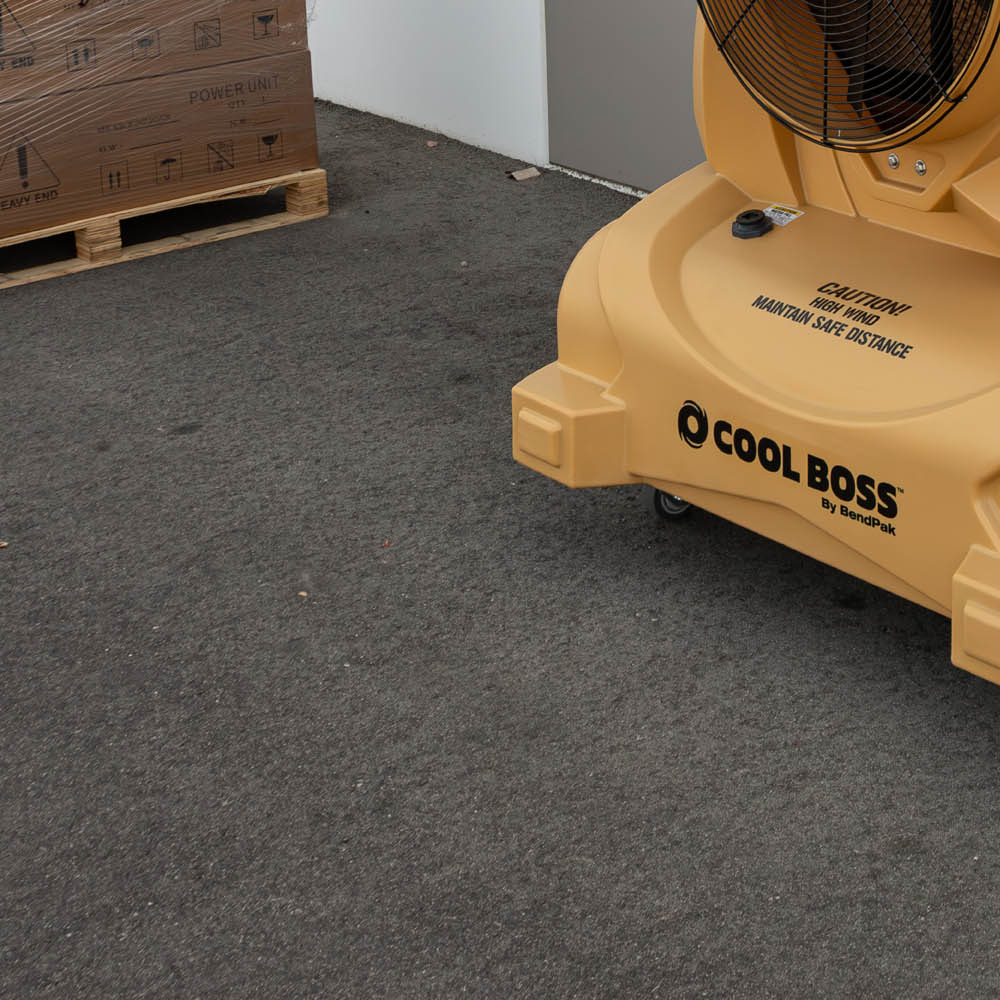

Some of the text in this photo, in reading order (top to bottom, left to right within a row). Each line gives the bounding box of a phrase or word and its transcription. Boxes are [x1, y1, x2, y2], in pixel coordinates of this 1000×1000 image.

[189, 73, 280, 104] POWER UNIT
[0, 194, 31, 210] EAVY
[809, 296, 881, 327] HIGH WIND
[817, 282, 912, 316] CAUTION!
[751, 295, 914, 359] MAINTAIN SAFE DISTANCE
[713, 420, 801, 483] COOL
[821, 496, 896, 537] By BendPak
